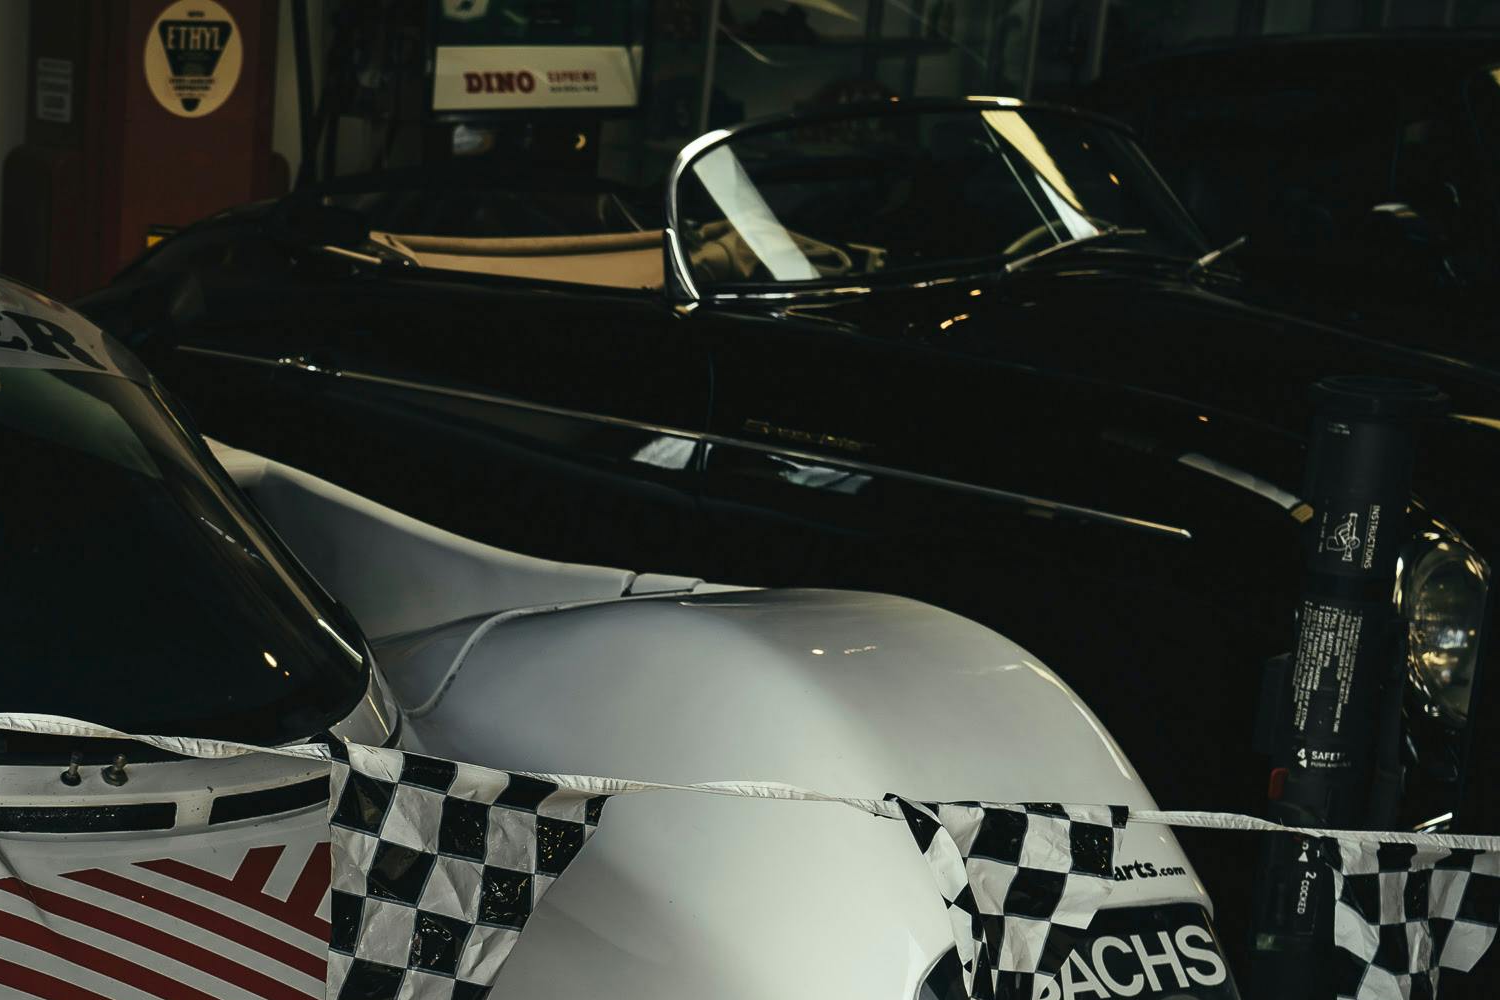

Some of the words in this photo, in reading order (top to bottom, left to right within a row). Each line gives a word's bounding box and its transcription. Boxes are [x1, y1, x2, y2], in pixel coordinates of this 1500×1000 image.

[167, 26, 221, 51] ETHYL
[465, 71, 535, 94] DINO
[1364, 504, 1381, 569] INSTRUCTIONS
[1297, 748, 1306, 760] 4
[1304, 871, 1316, 880] 2
[1297, 880, 1309, 915] COCKED
